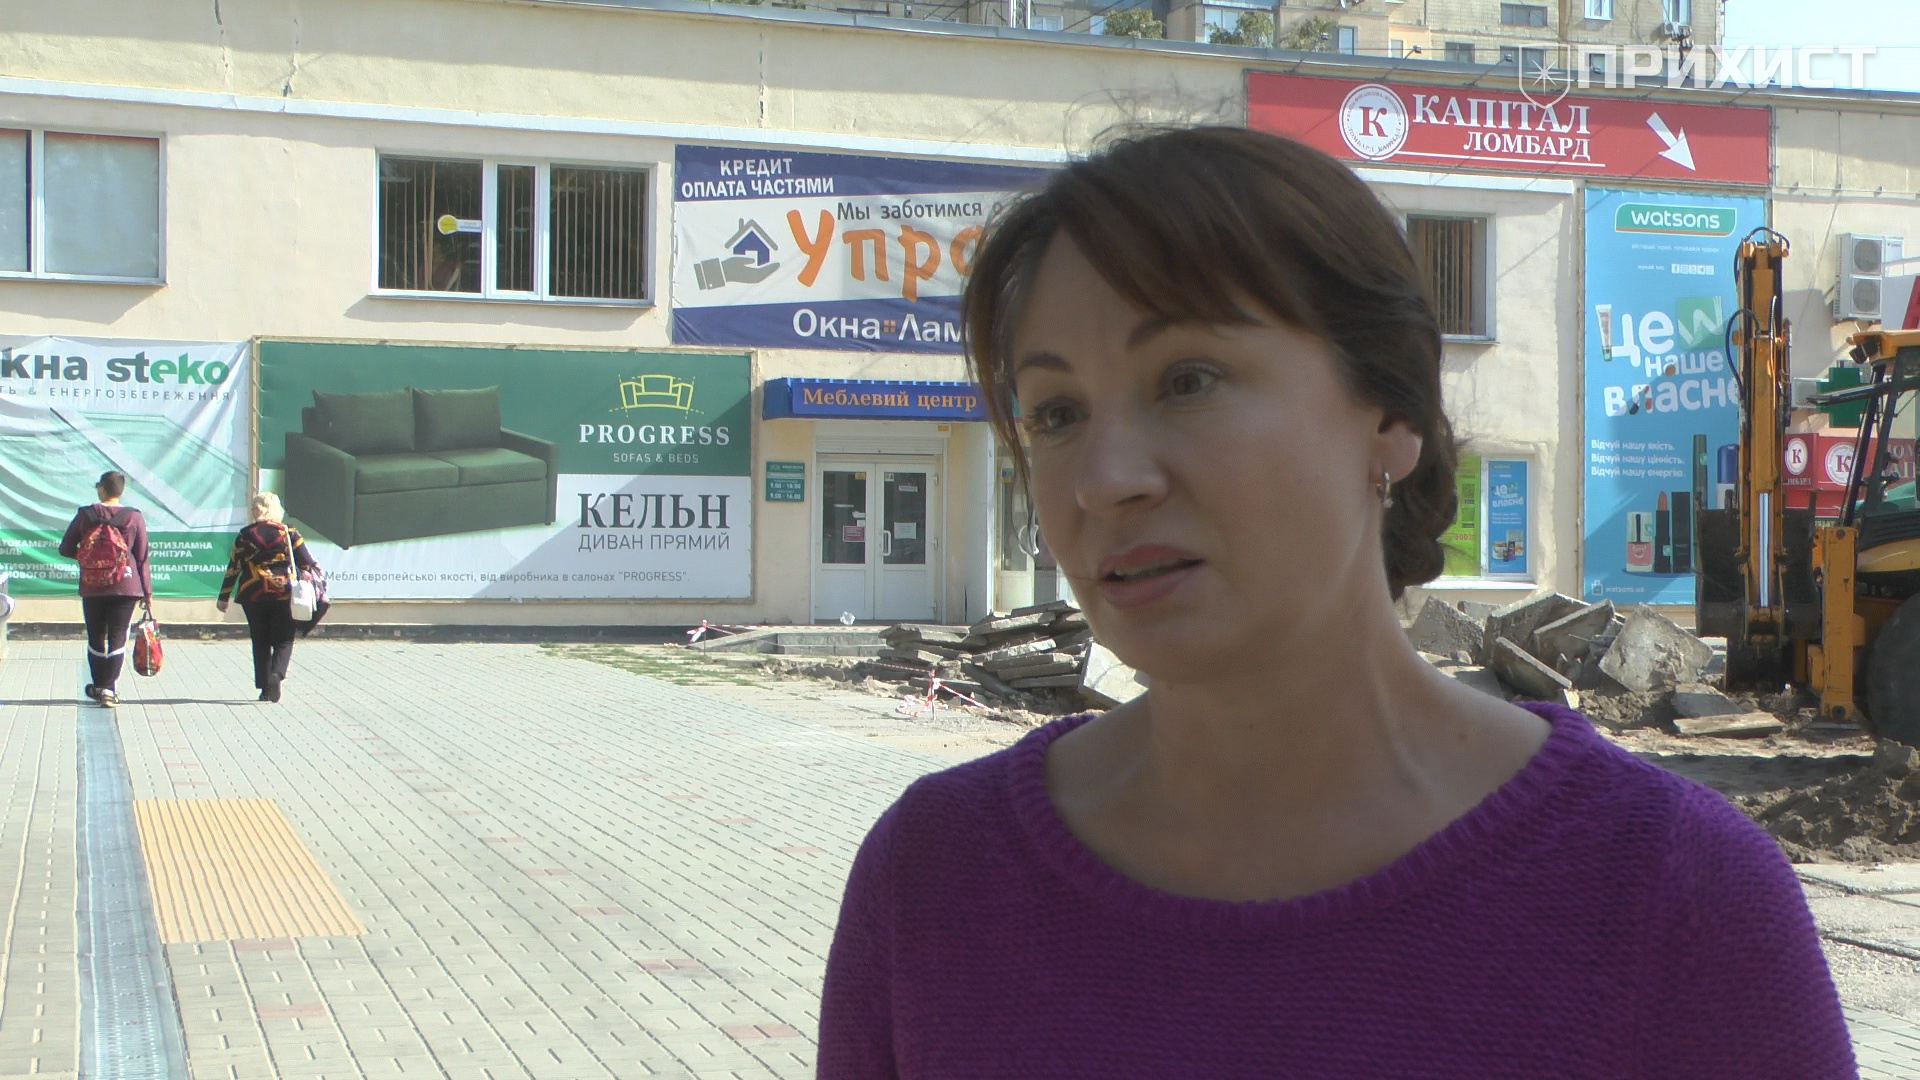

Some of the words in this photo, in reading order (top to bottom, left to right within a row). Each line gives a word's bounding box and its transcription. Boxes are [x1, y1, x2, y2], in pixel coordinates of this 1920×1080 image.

[1358, 105, 1389, 138] К
[1412, 93, 1591, 134] КАПІТАЛ
[1463, 131, 1591, 162] ЛОМБАРД
[720, 158, 792, 177] КРЕДИТ
[681, 180, 747, 198] ОПЛАТА
[751, 177, 834, 196] ЧАСТЯМИ
[837, 202, 870, 221] Мы
[880, 199, 982, 220] заботимся
[1631, 209, 1721, 230] watsons
[793, 308, 881, 340] Окна
[106, 351, 230, 386] steko
[1644, 350, 1724, 378] наше
[50, 387, 230, 401] ЕНЕРГОЗБЕРЕЖЕННЯ
[803, 387, 909, 407] Меблевий
[917, 393, 977, 412] центр
[578, 424, 730, 446] PROGRESS
[1591, 439, 1620, 451] Відчуй
[1622, 442, 1645, 452] нашу
[613, 453, 651, 463] SOFAS
[655, 453, 663, 463] &
[668, 453, 699, 464] BEDS
[1591, 453, 1620, 465] Відчуй
[1622, 455, 1645, 465] нашу
[1591, 466, 1620, 478] Відчуй
[1622, 468, 1645, 478] нашу
[577, 492, 731, 530] КЕЛЬН
[578, 534, 644, 552] ДИВАН
[650, 531, 730, 550] ПРЯМИЙ
[325, 571, 358, 581] Меблі
[361, 571, 437, 585] європейської
[440, 571, 477, 583] якості,
[480, 572, 498, 582] від
[500, 572, 559, 585] виробника
[571, 573, 615, 582] салонах
